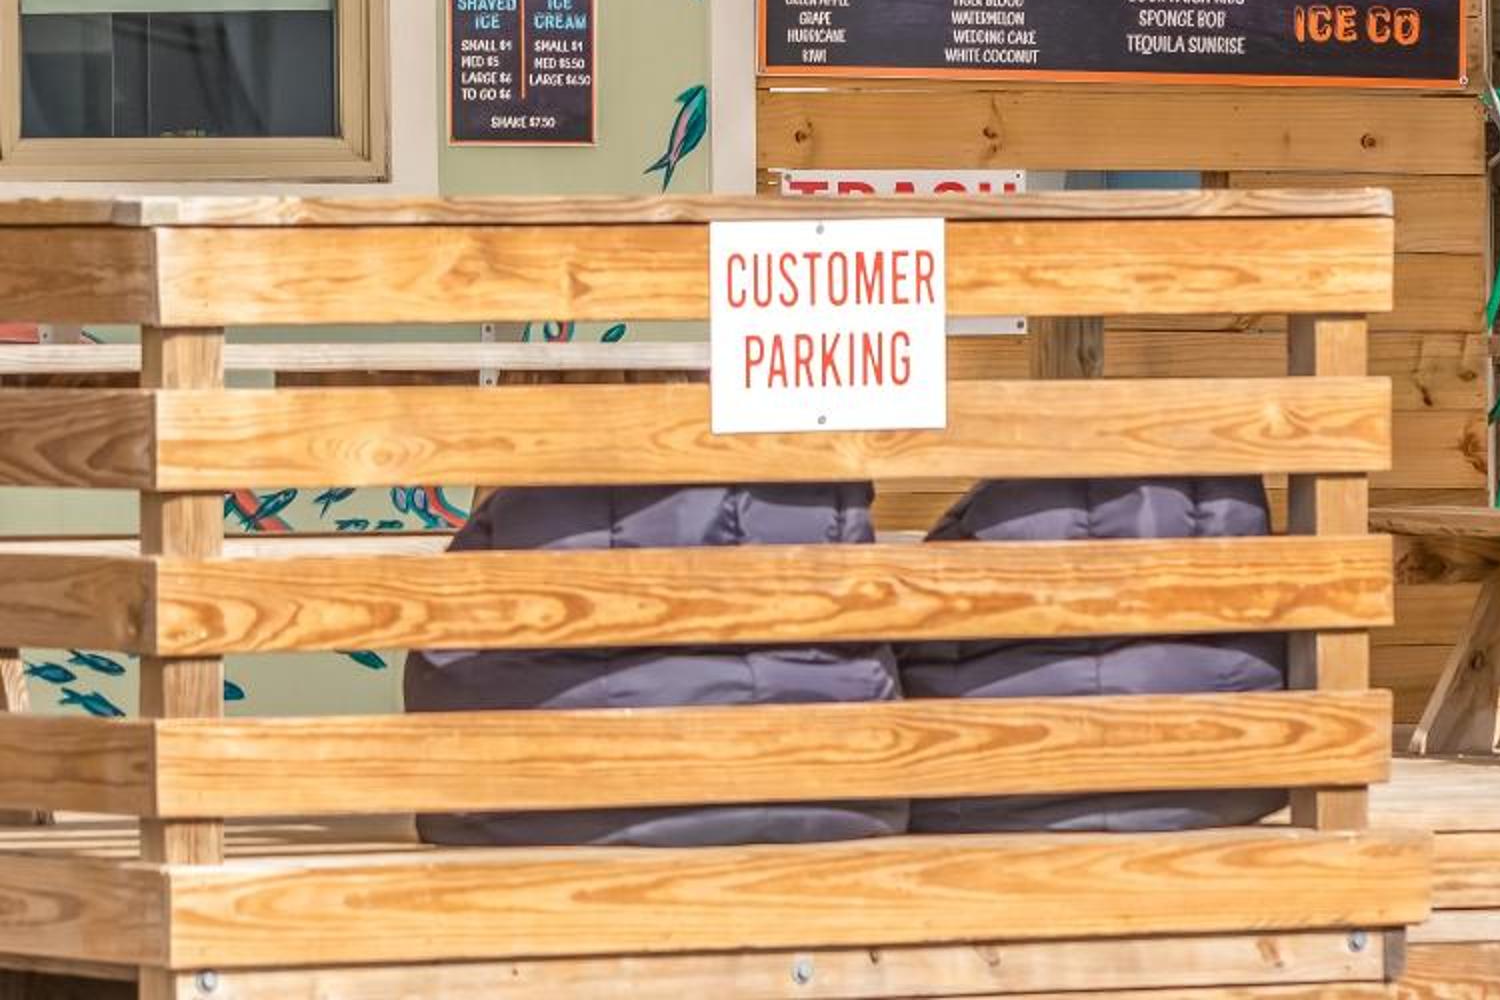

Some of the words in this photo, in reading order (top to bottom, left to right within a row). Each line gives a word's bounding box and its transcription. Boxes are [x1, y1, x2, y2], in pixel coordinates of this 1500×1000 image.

[475, 14, 500, 29] ICE
[534, 14, 587, 29] CREAM
[800, 11, 832, 25] GRAPE
[952, 11, 1024, 25] WATERMELON
[1139, 10, 1194, 27] SPONGE
[1197, 11, 1225, 28] BOB
[1294, 5, 1357, 43] ICE
[1367, 7, 1421, 45] CO
[787, 28, 846, 42] HURRICANE
[954, 30, 1004, 44] WEDDING
[1008, 30, 1036, 44] CAKE
[461, 39, 497, 51] SMALL
[534, 40, 569, 52] SMALL
[1126, 34, 1185, 54] TEQUILA
[1188, 36, 1246, 54] SUNRISE
[462, 56, 484, 68] MED
[487, 56, 499, 67] $5
[802, 49, 827, 62] KIWI
[945, 48, 980, 63] WHITE
[983, 49, 1039, 63] COCONUT
[534, 57, 556, 69] MED
[462, 72, 498, 85] LARGE
[529, 74, 564, 86] LARGE
[462, 88, 476, 100] TO
[480, 88, 496, 100] GO
[491, 116, 526, 129] SHAKE
[727, 250, 935, 308] CUSTOMER
[745, 331, 911, 389] PARKING
